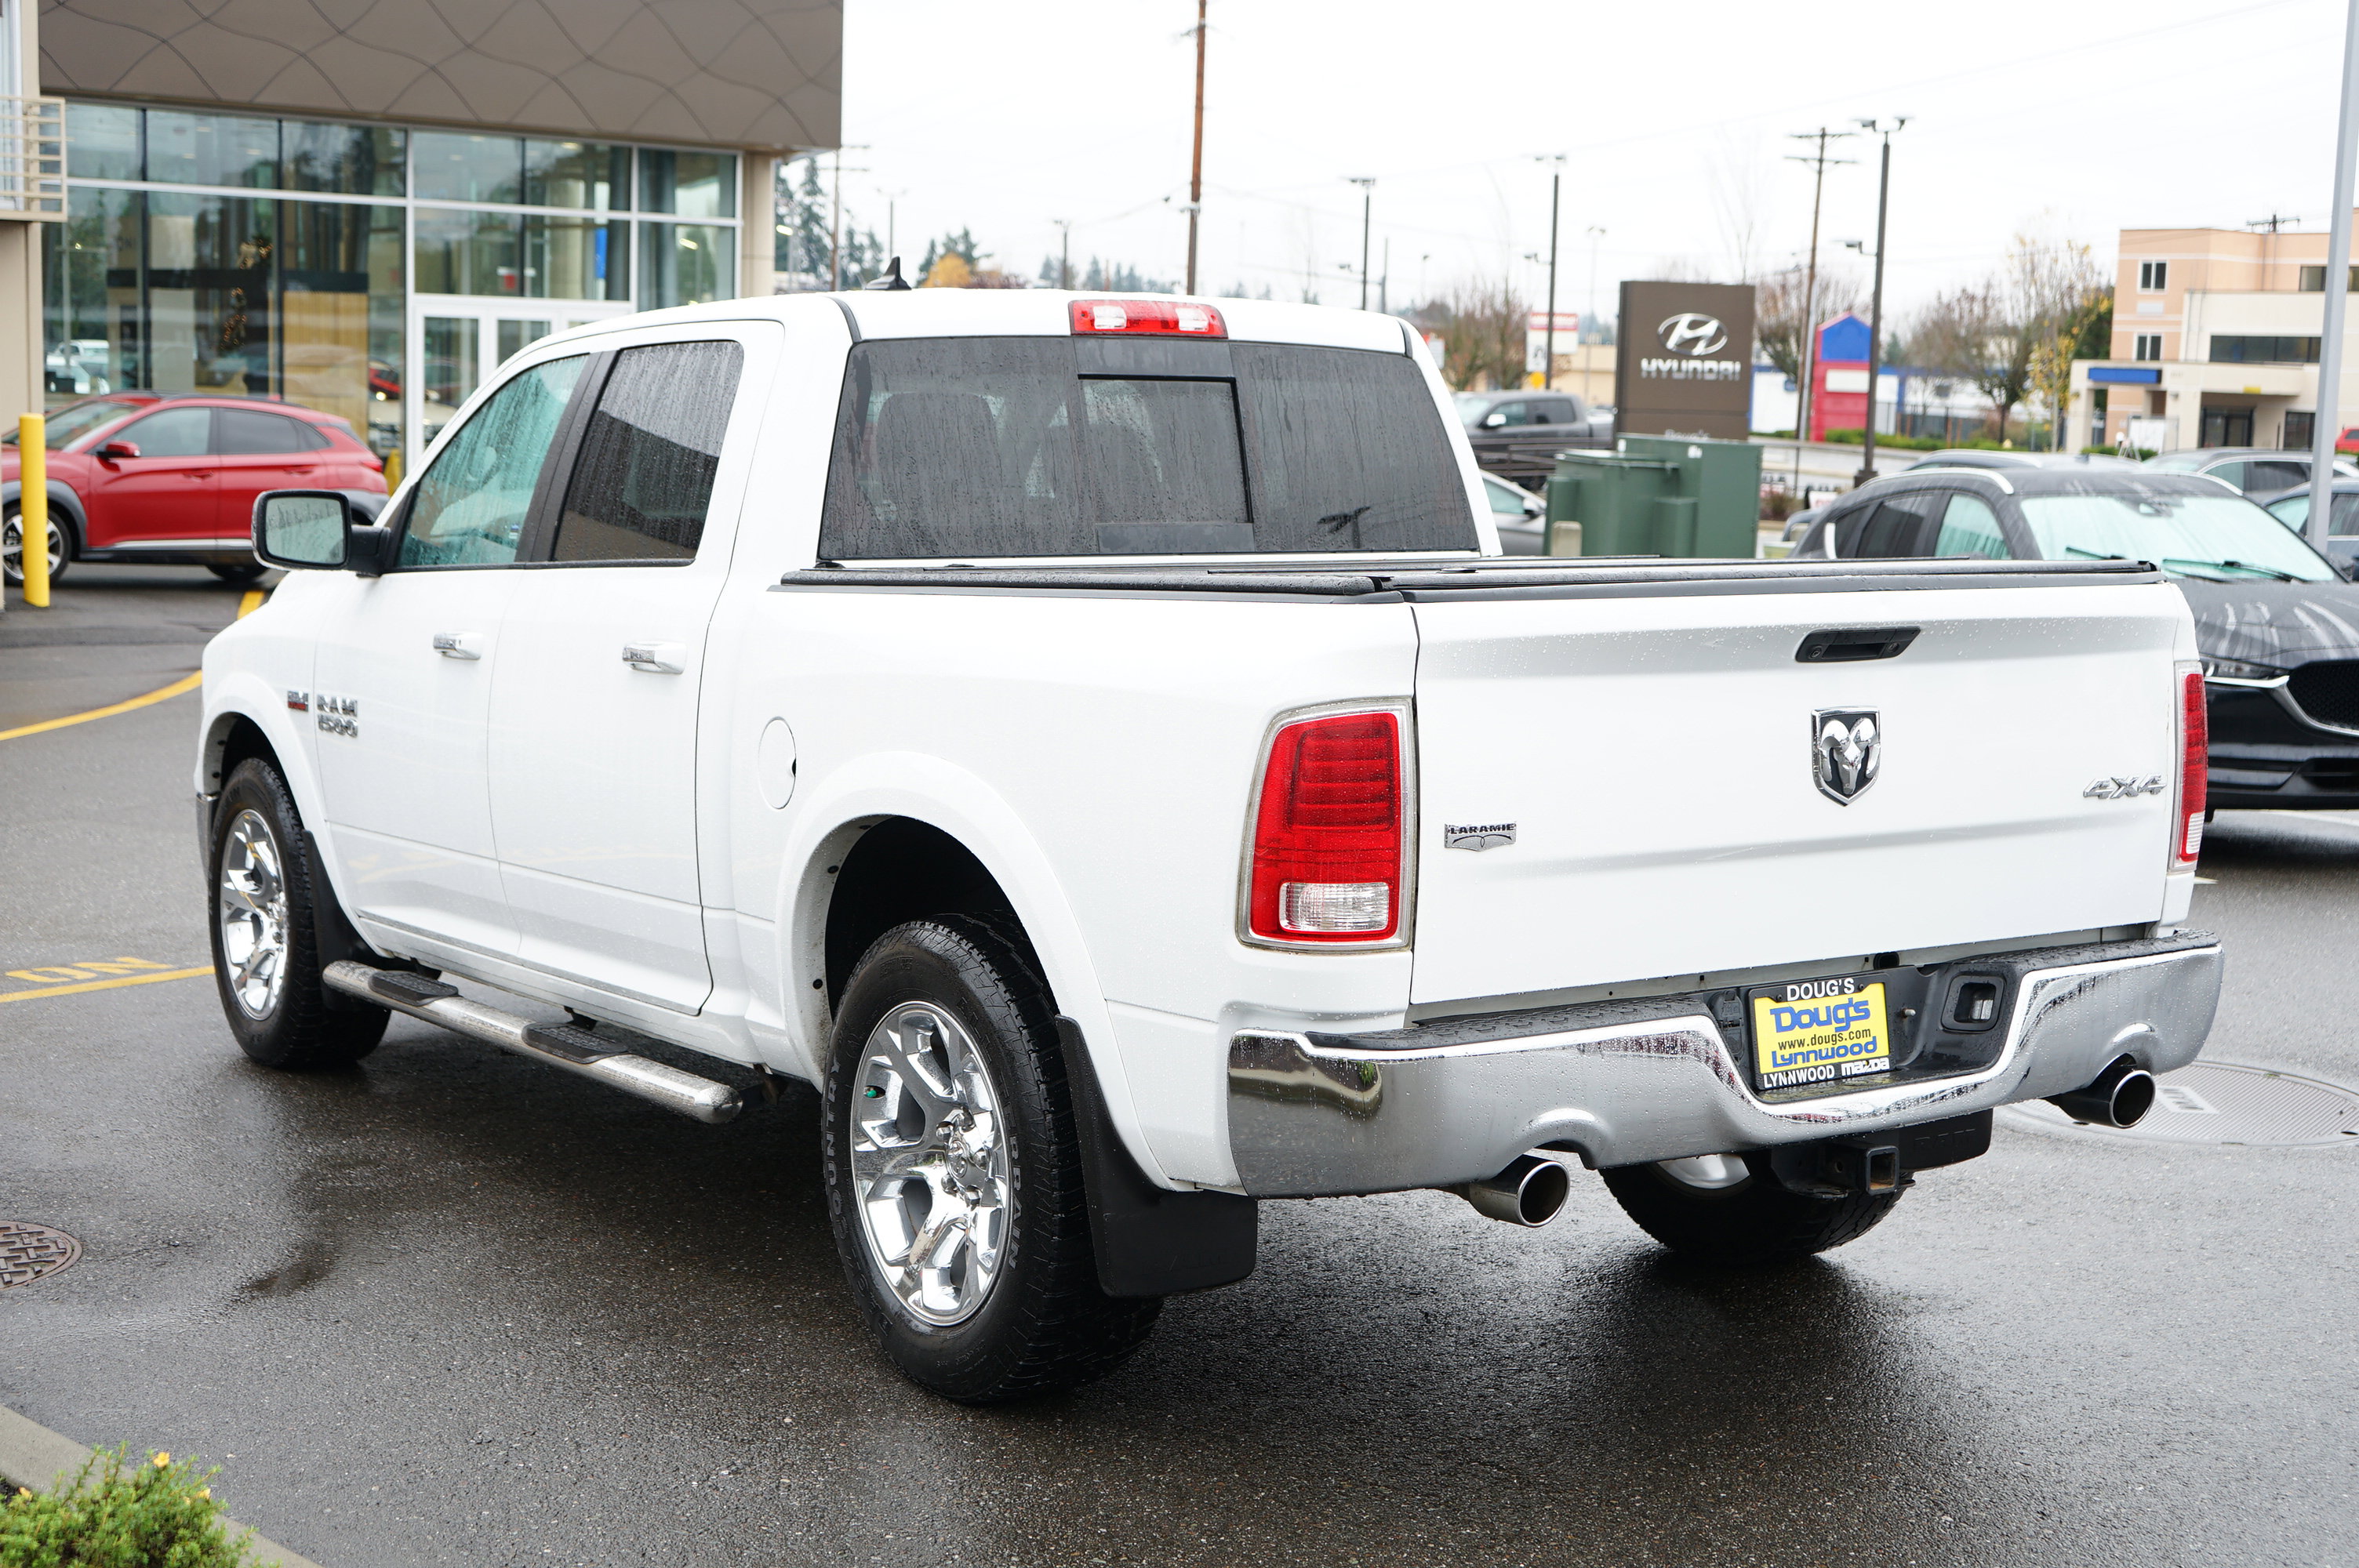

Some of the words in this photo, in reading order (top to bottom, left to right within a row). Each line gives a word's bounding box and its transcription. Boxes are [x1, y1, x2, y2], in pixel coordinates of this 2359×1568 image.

[1641, 358, 1741, 380] HYUNDAI
[1450, 823, 1514, 834] LARAMIE
[1787, 978, 1855, 1001] DOUG'S
[1778, 1029, 1871, 1051] www.dougs.com
[1771, 1036, 1877, 1068] Lynnwood
[1764, 1065, 1835, 1088] LYNNWOOD
[825, 1056, 848, 1240] COUNTRY
[998, 1070, 1022, 1270] TERRAIN
